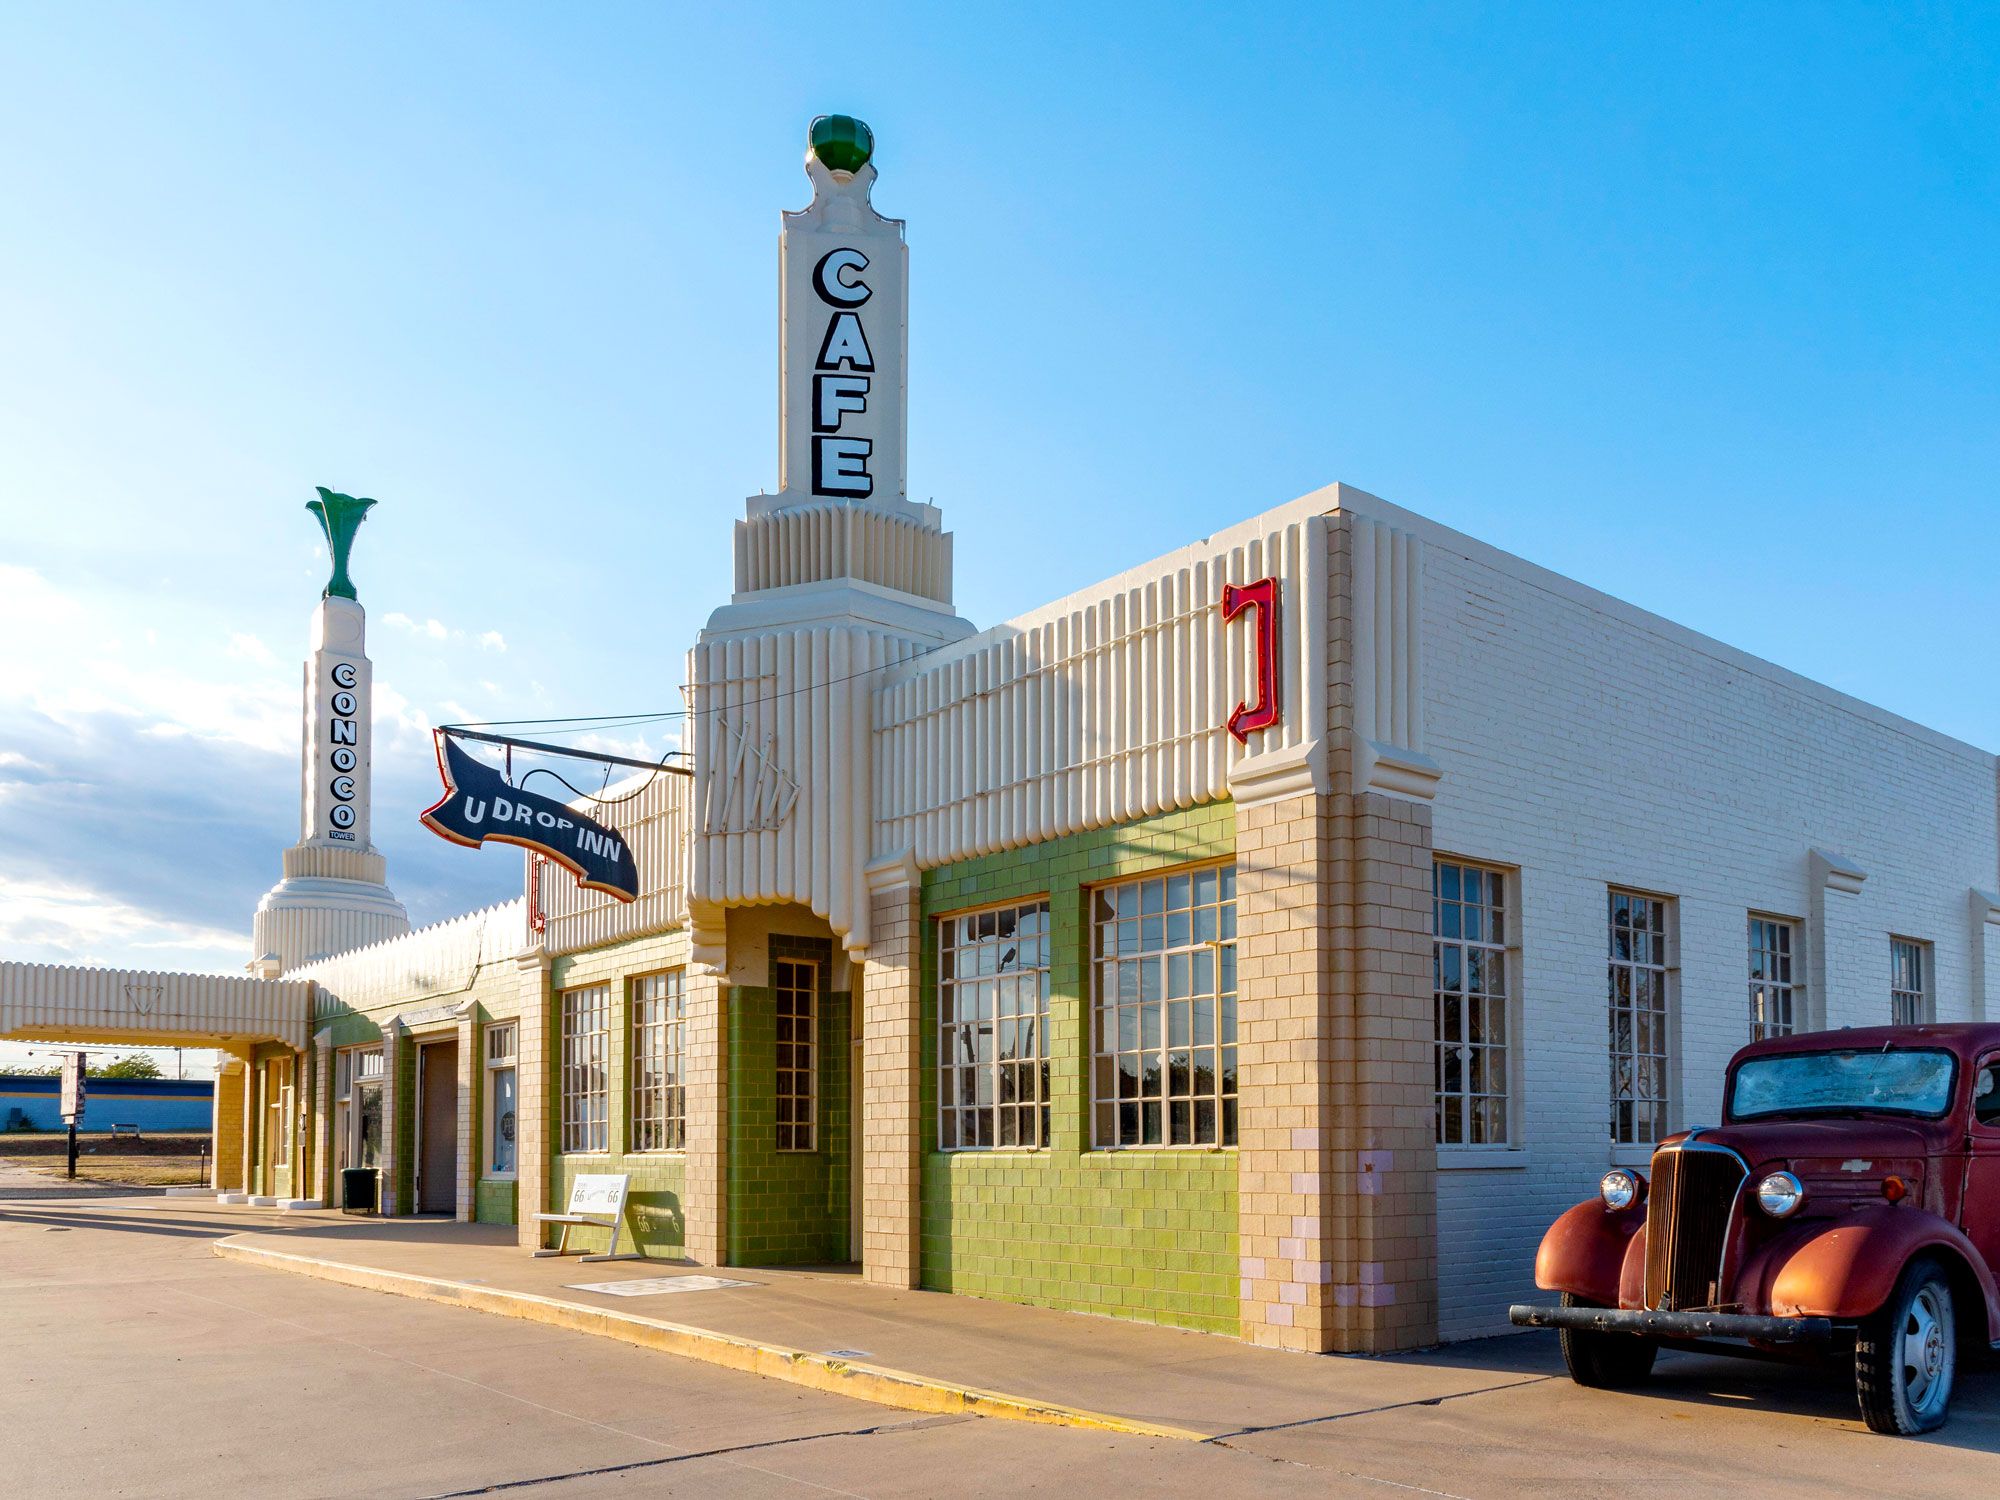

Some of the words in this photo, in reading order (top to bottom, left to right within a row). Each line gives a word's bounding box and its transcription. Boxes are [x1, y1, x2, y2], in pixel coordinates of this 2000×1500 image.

[812, 247, 875, 499] CAFE
[329, 663, 357, 830] CONOCO
[329, 831, 355, 841] TOWER
[464, 796, 486, 824] U
[491, 796, 574, 830] DROP
[576, 827, 622, 863] INN
[574, 1189, 585, 1203] 66
[607, 1190, 619, 1203] 66
